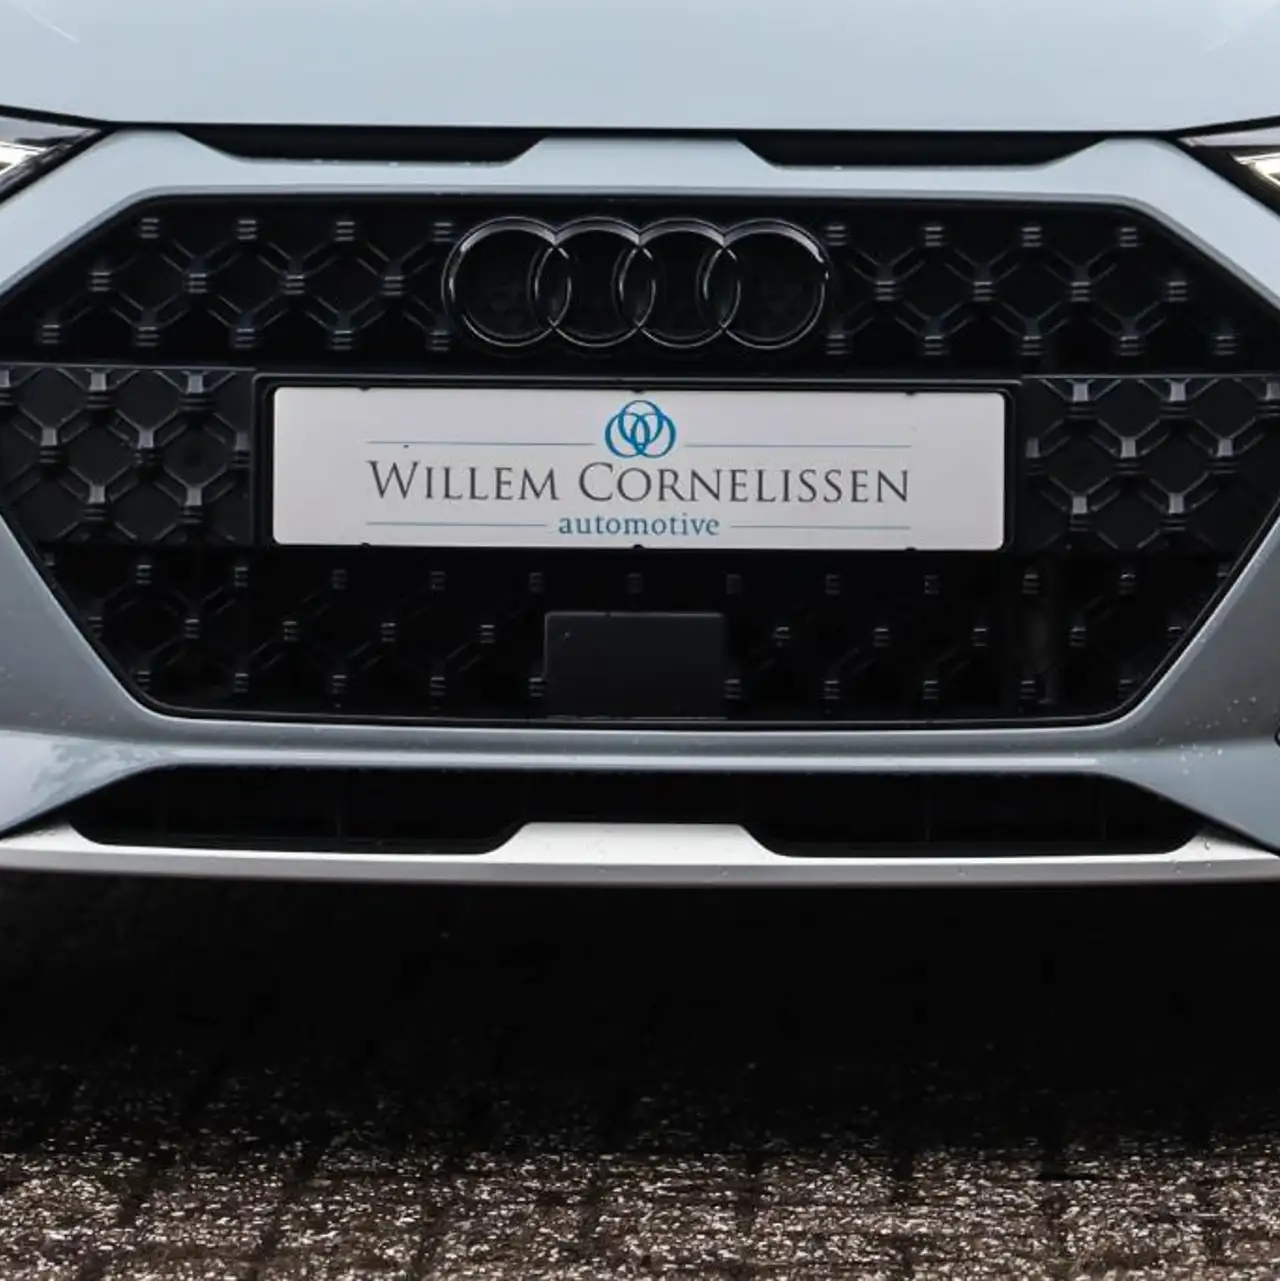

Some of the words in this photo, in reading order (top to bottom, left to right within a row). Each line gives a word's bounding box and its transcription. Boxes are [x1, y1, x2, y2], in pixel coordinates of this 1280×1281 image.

[367, 460, 559, 501] WILLEM
[578, 462, 910, 503] CORNELISSEN
[558, 512, 720, 536] automotive
